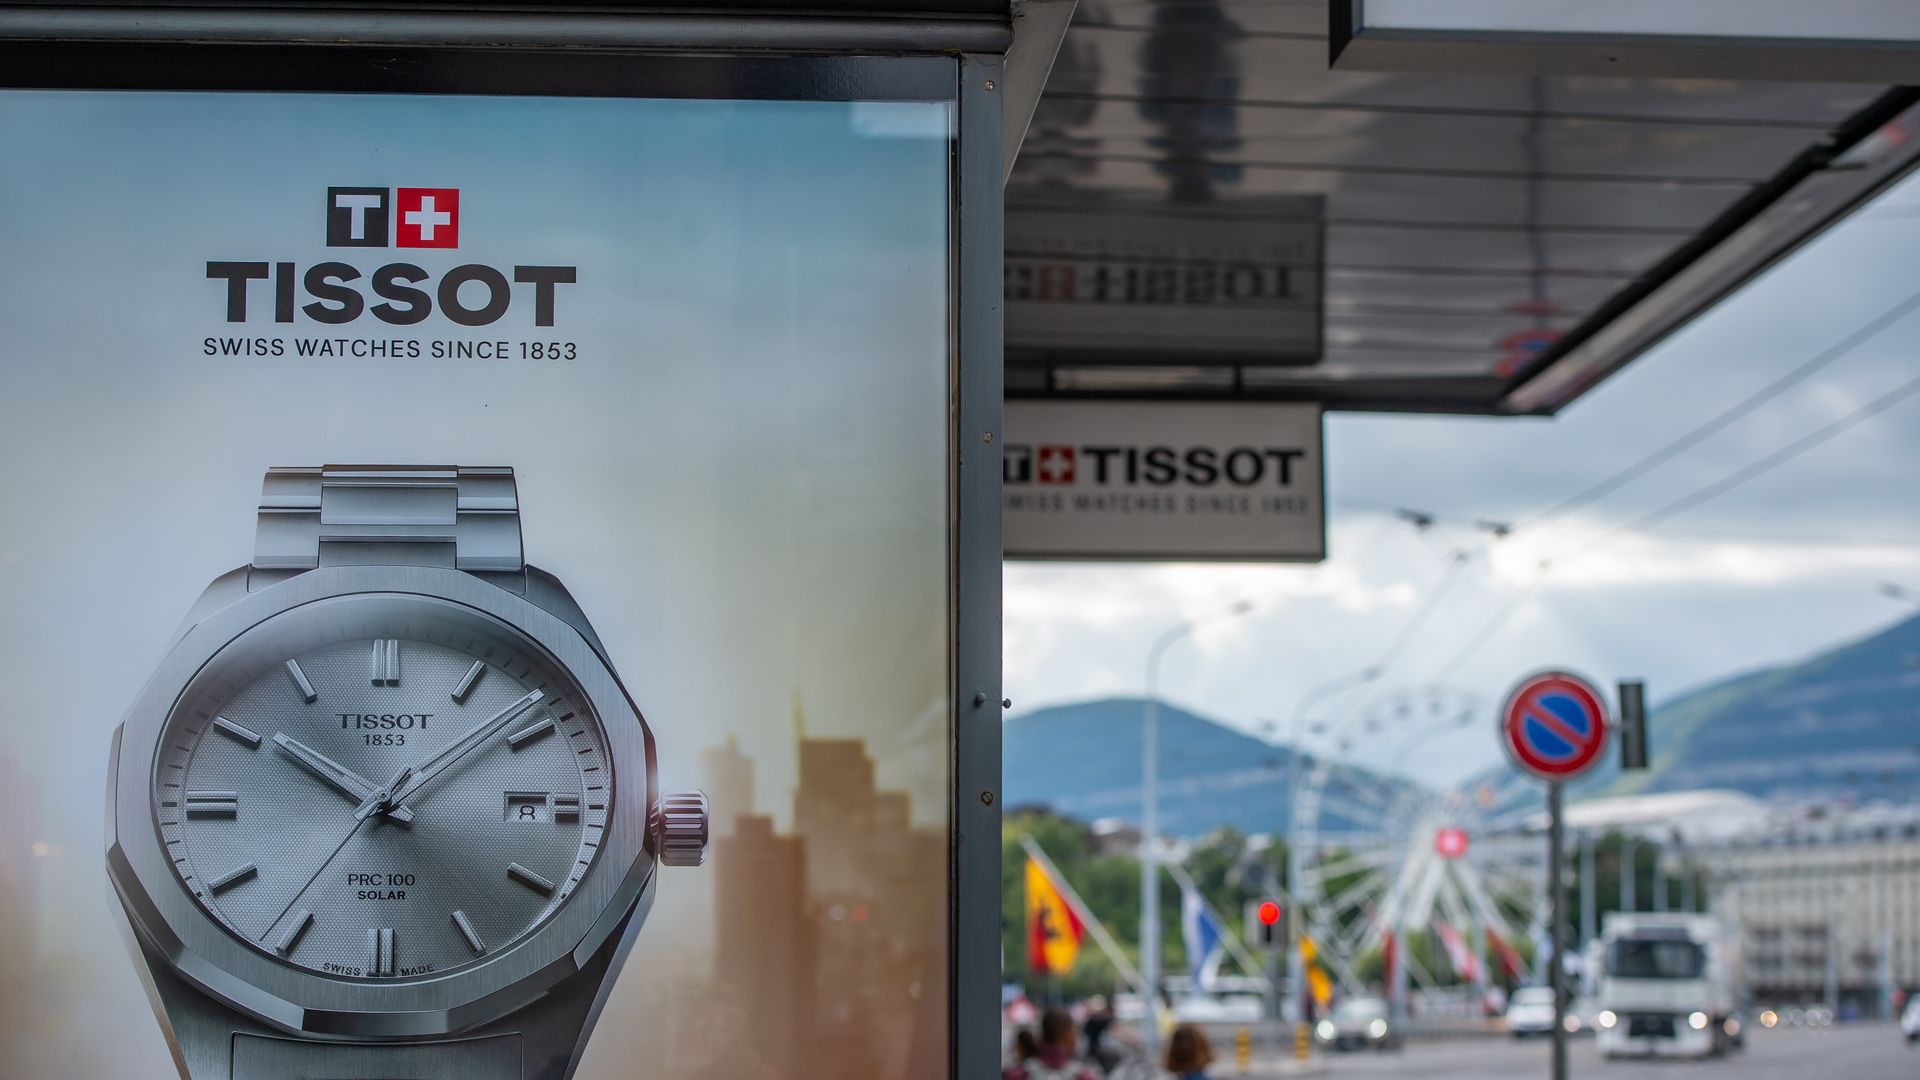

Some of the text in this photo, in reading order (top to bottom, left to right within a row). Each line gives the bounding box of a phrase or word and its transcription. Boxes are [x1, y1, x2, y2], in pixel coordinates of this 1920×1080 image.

[334, 193, 383, 241] T
[206, 261, 577, 327] TISSOT
[203, 337, 577, 361] SWISS WATCHES SINCE 1853
[1080, 447, 1304, 486] TISSOT
[335, 713, 434, 730] TISSOT
[363, 733, 405, 746] 1853
[348, 873, 415, 887] PRC 100
[357, 890, 406, 900] SOLAR
[322, 962, 435, 977] SWISS MADE
